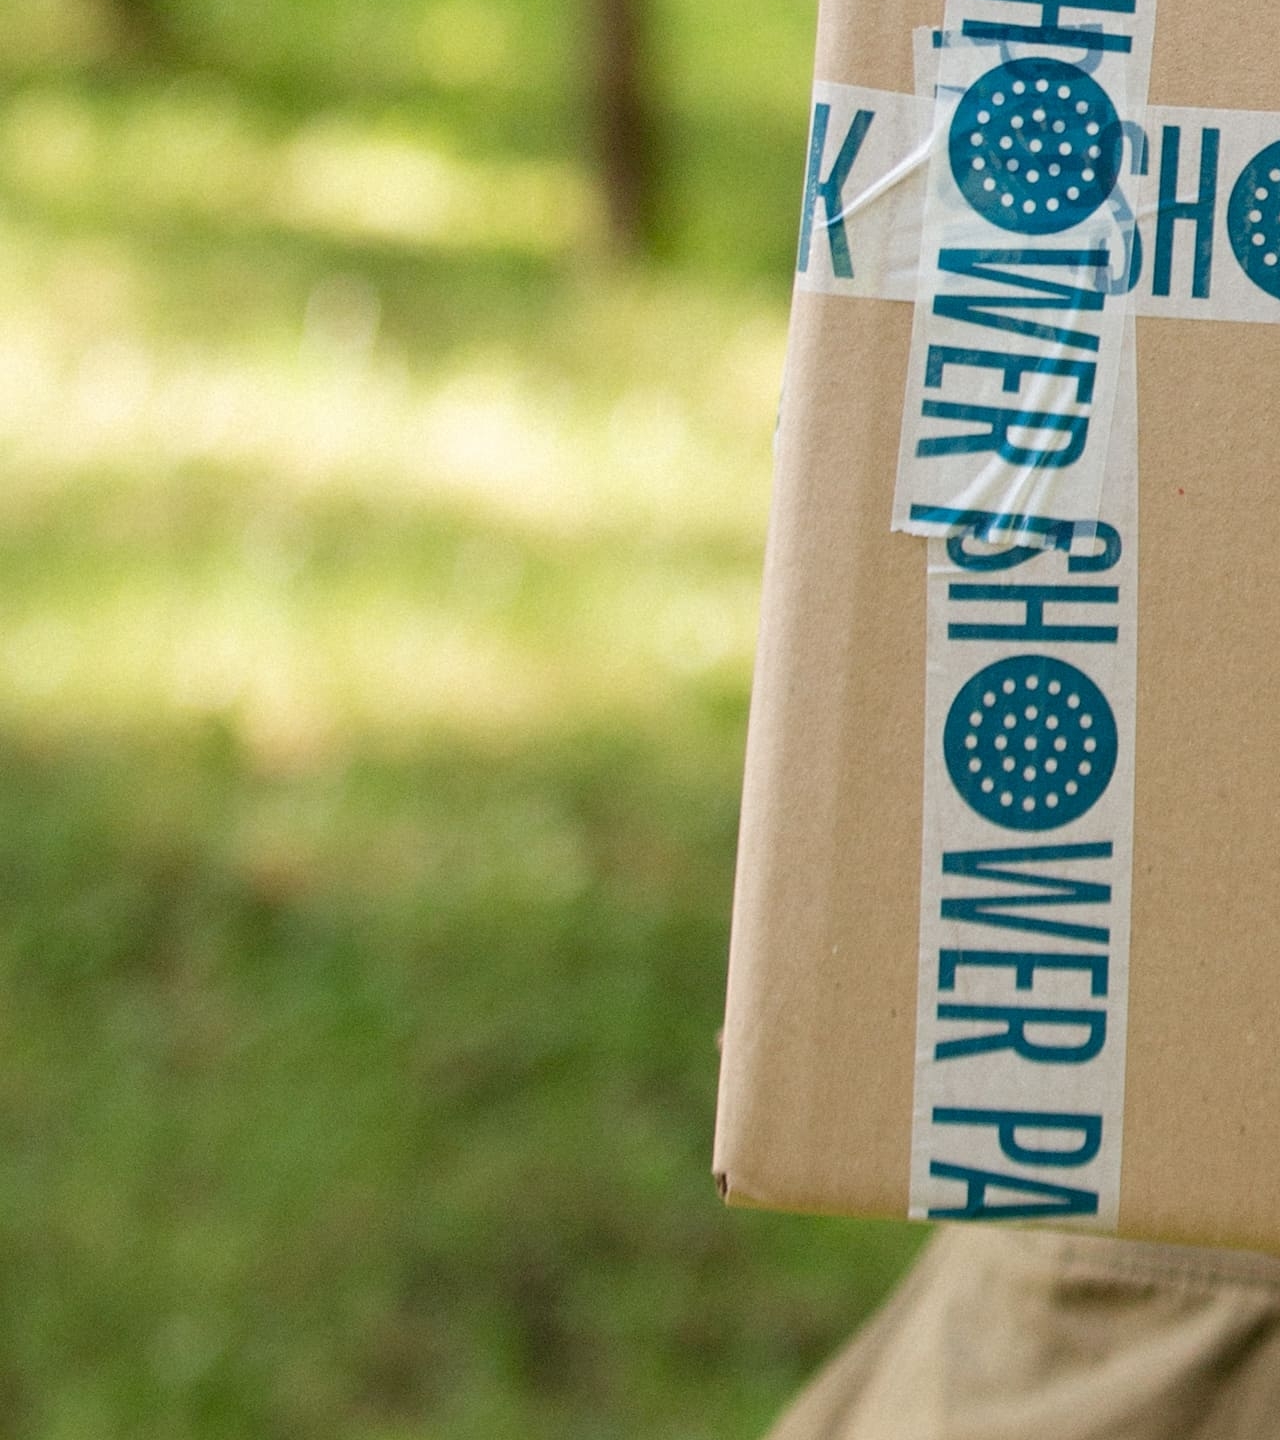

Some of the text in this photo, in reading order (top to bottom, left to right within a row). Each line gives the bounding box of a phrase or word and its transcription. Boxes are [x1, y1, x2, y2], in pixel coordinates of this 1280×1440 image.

[798, 102, 876, 279] K
[934, 520, 1122, 1065] SHOWER
[928, 1106, 1103, 1219] PA
